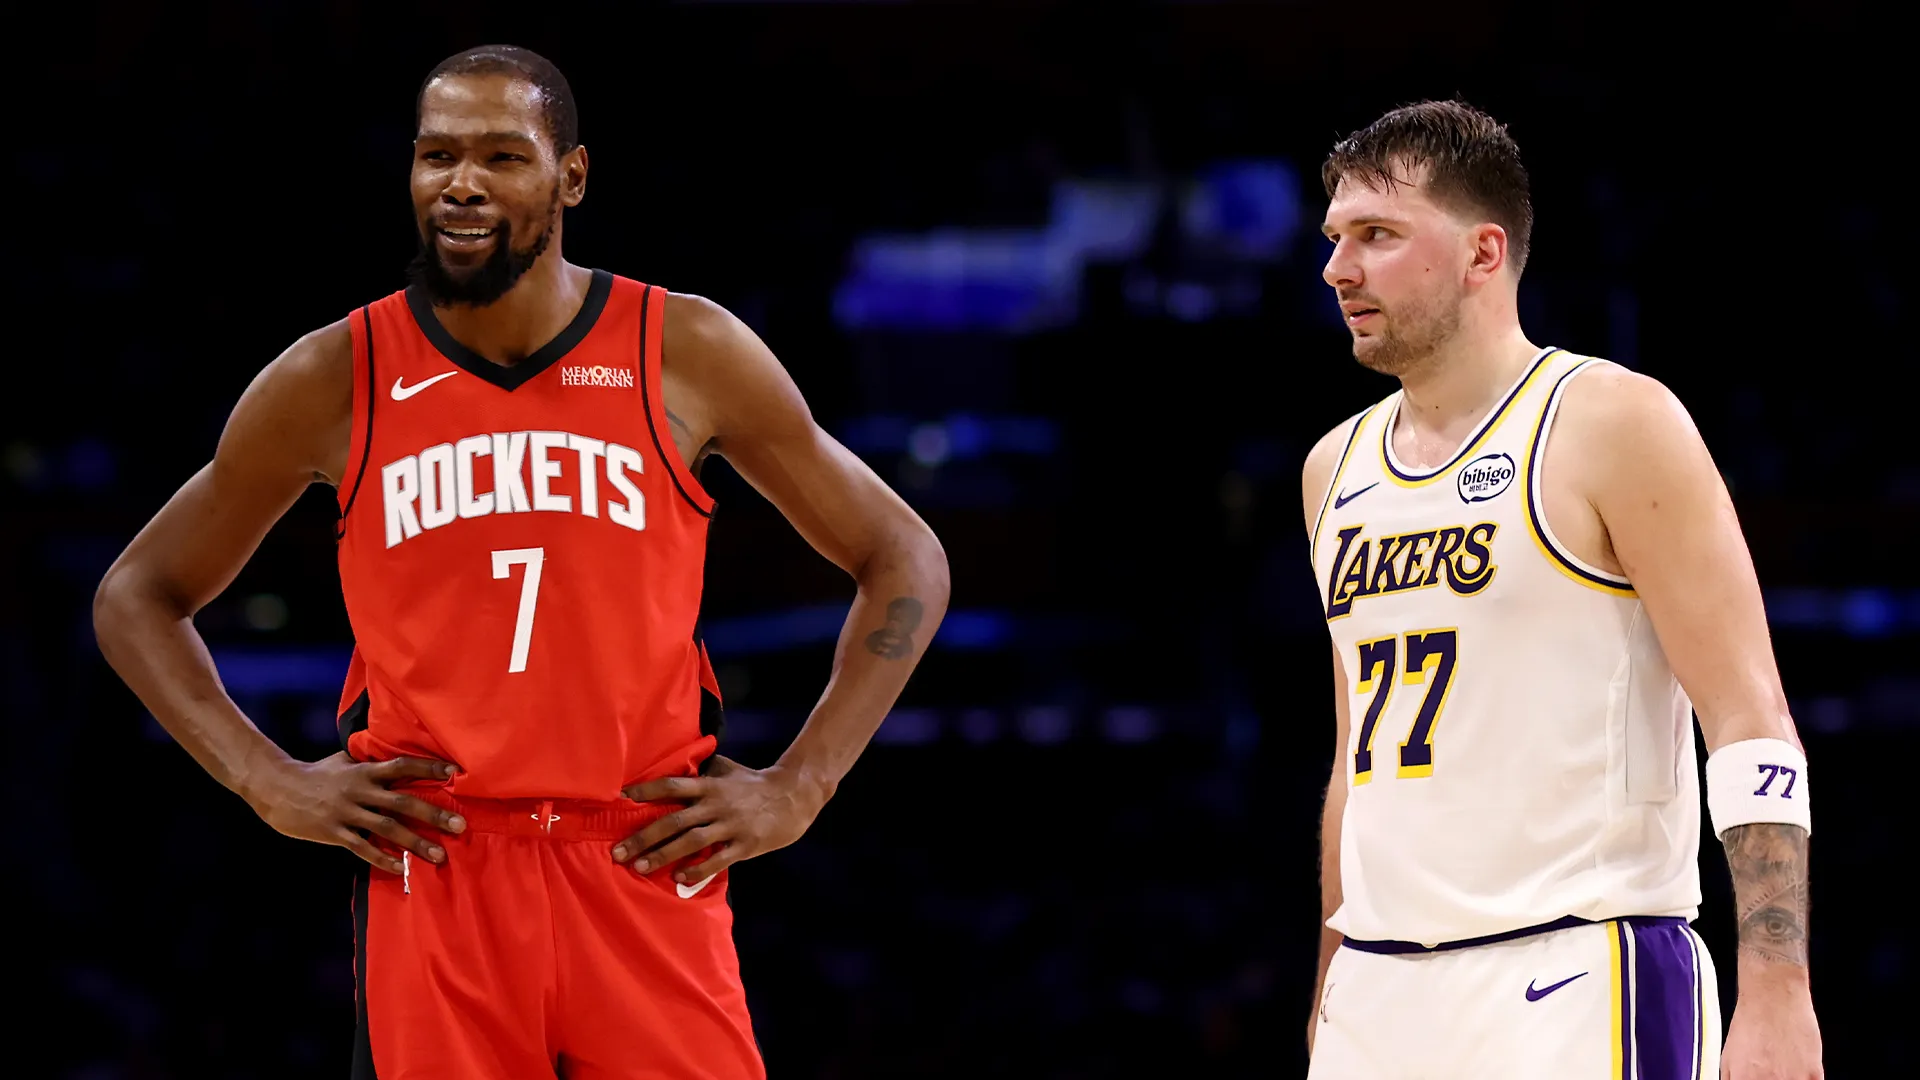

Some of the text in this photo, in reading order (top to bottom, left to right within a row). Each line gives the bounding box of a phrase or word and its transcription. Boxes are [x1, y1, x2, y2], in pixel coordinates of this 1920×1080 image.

[562, 365, 634, 379] MEMORIAL
[562, 375, 634, 388] HERMANN
[381, 430, 646, 549] ROCKETS
[1462, 465, 1511, 486] bibigo
[1326, 522, 1500, 624] LAKERS
[490, 547, 545, 673] 7
[1352, 626, 1459, 787] 77
[1753, 763, 1797, 799] 77
